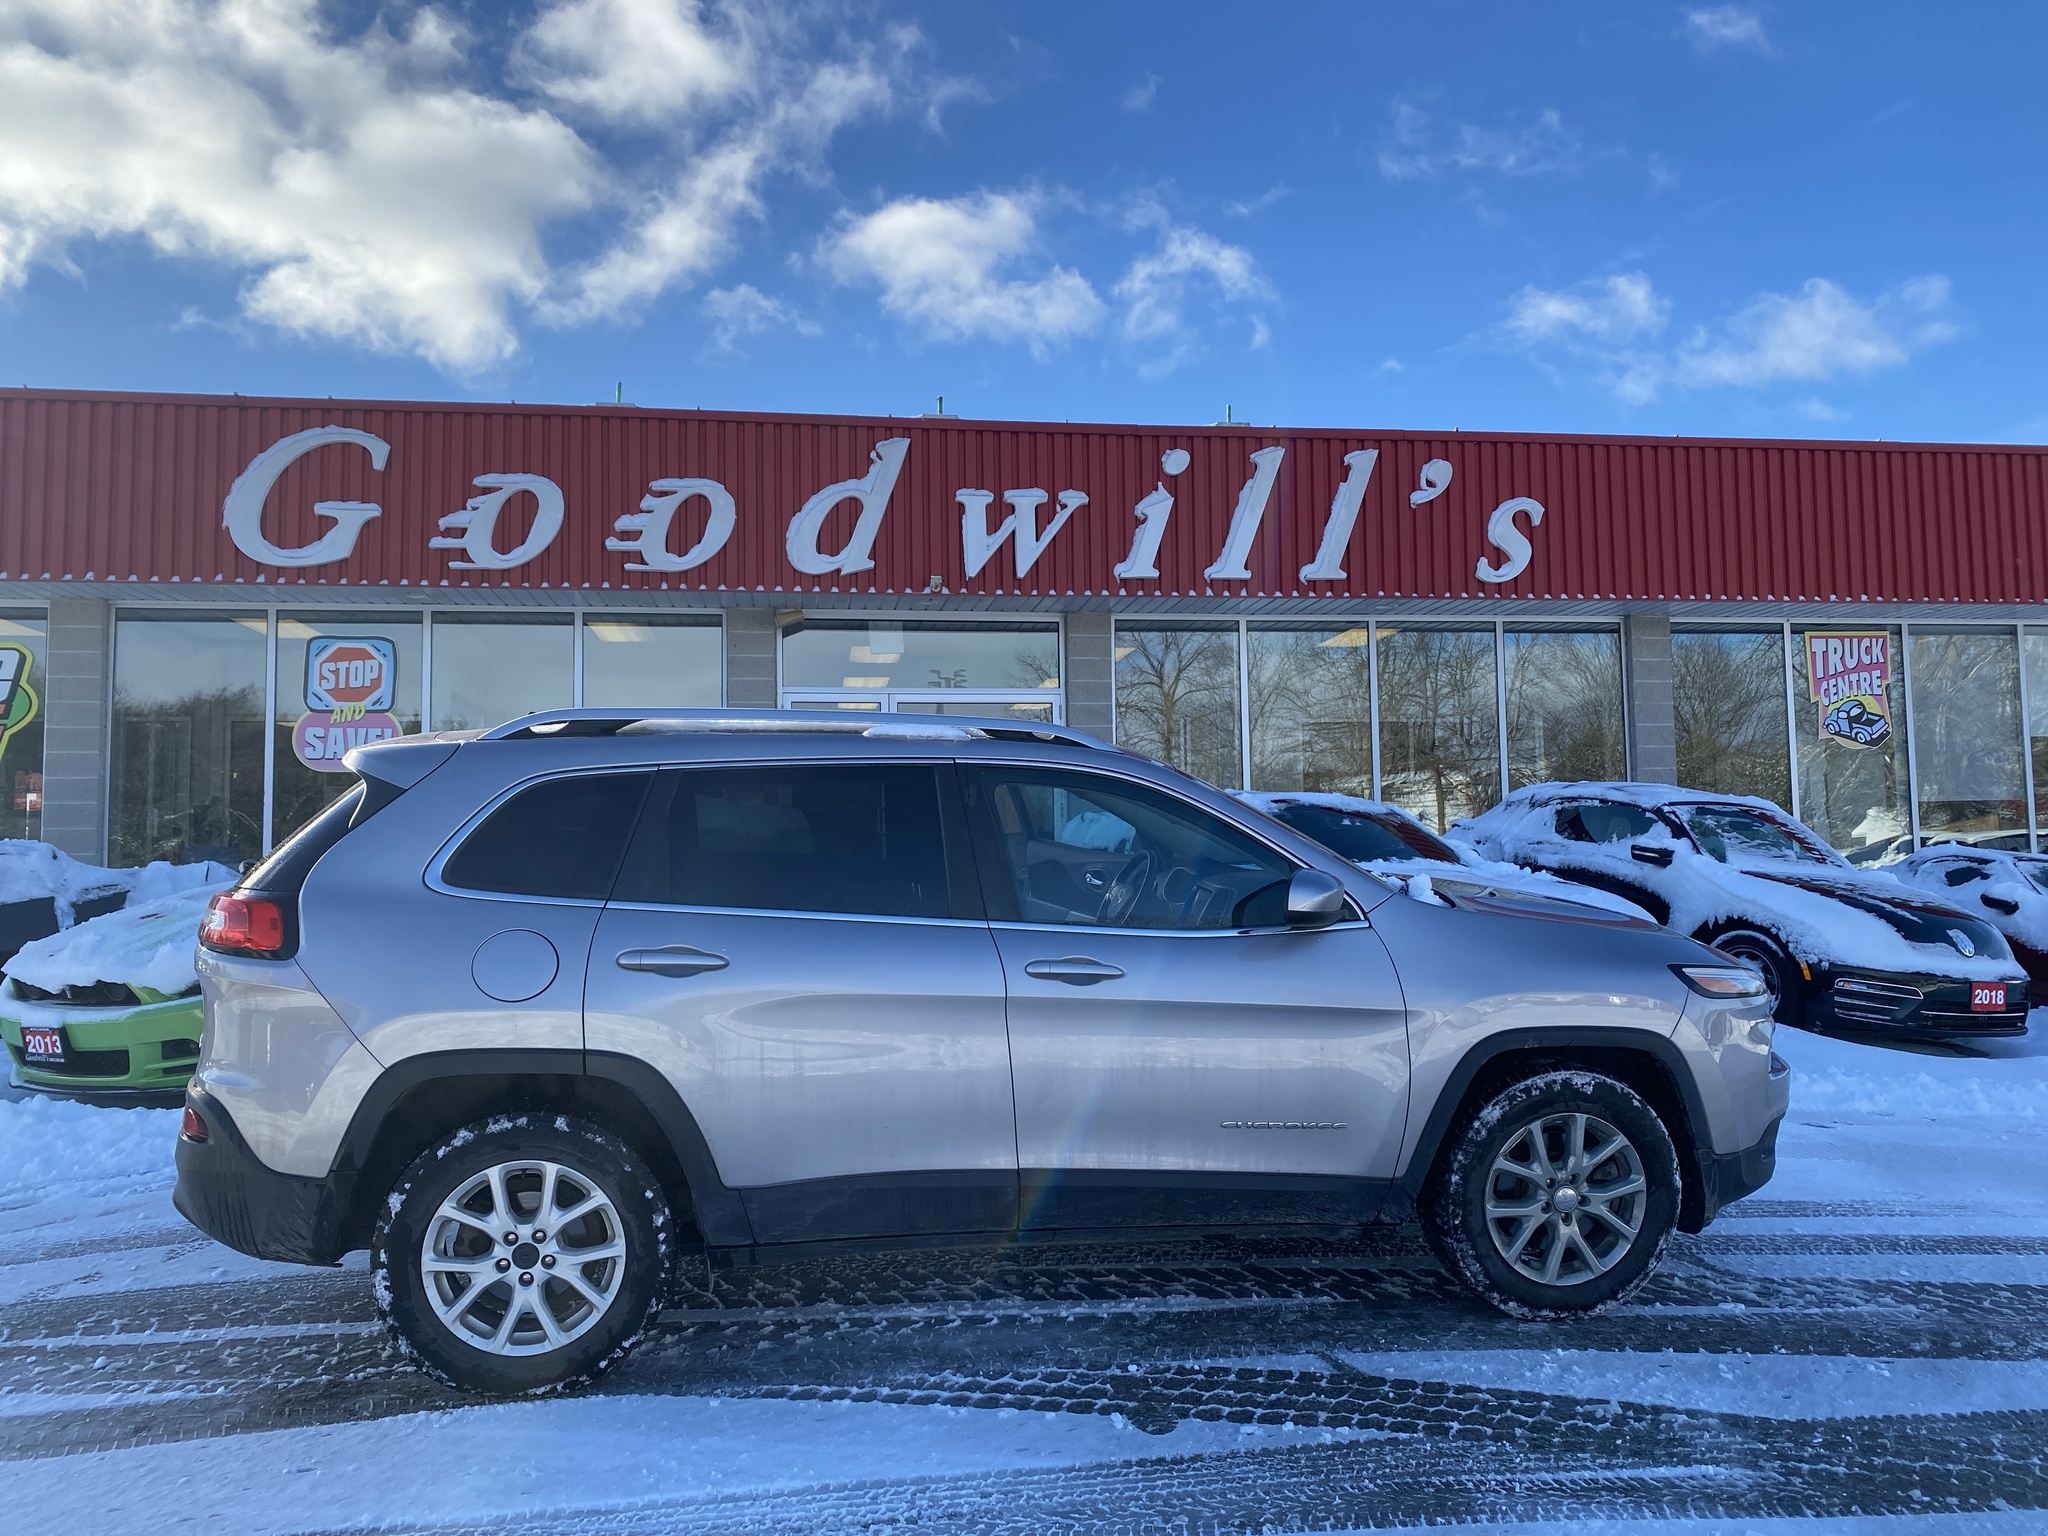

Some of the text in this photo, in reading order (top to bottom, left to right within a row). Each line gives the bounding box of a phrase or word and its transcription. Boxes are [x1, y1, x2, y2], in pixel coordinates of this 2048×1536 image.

[222, 424, 1545, 584] Goodwill's
[1811, 637, 1886, 679] TRUCK
[321, 660, 379, 690] STOP
[1820, 669, 1884, 707] CENTRE
[330, 703, 366, 724] AND
[1974, 988, 2005, 1005] 2018
[25, 1034, 62, 1054] 2013
[1220, 1120, 1348, 1130] CHEROKEE
